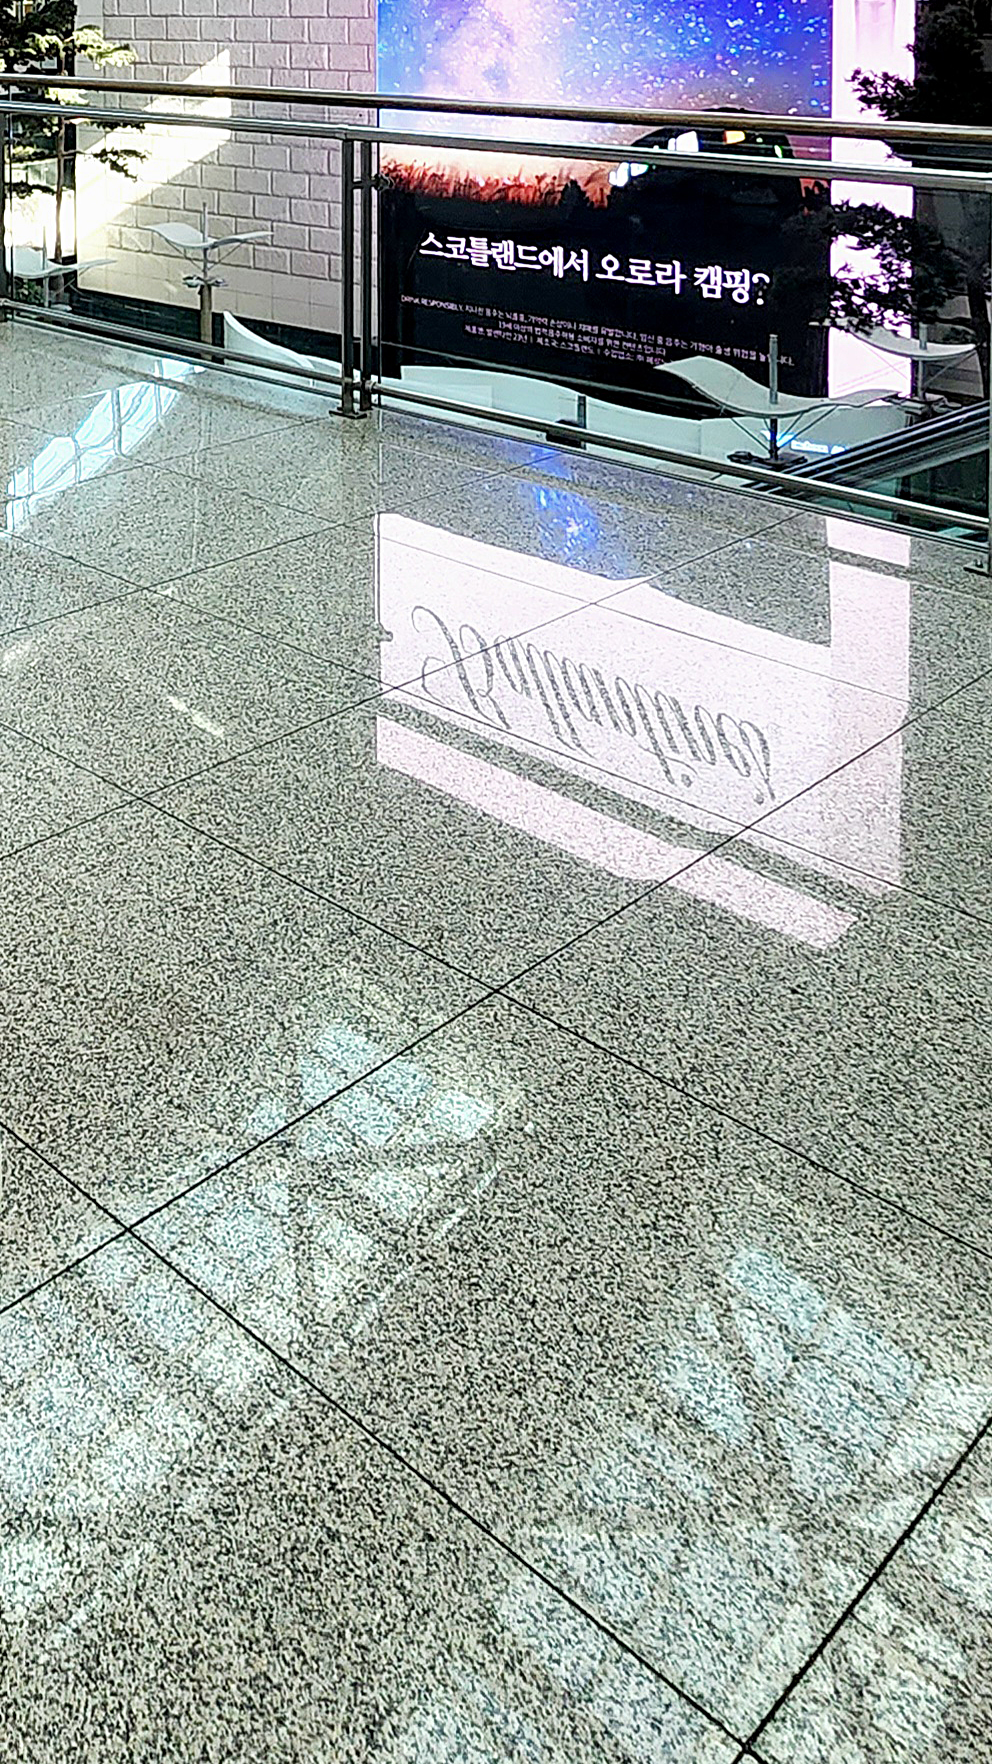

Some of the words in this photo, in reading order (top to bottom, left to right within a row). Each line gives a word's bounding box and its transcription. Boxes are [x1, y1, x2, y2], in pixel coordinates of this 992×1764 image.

[419, 232, 588, 282] 스코틀랜드에서
[595, 254, 687, 294] 오로라
[693, 266, 770, 306] 캠핑?
